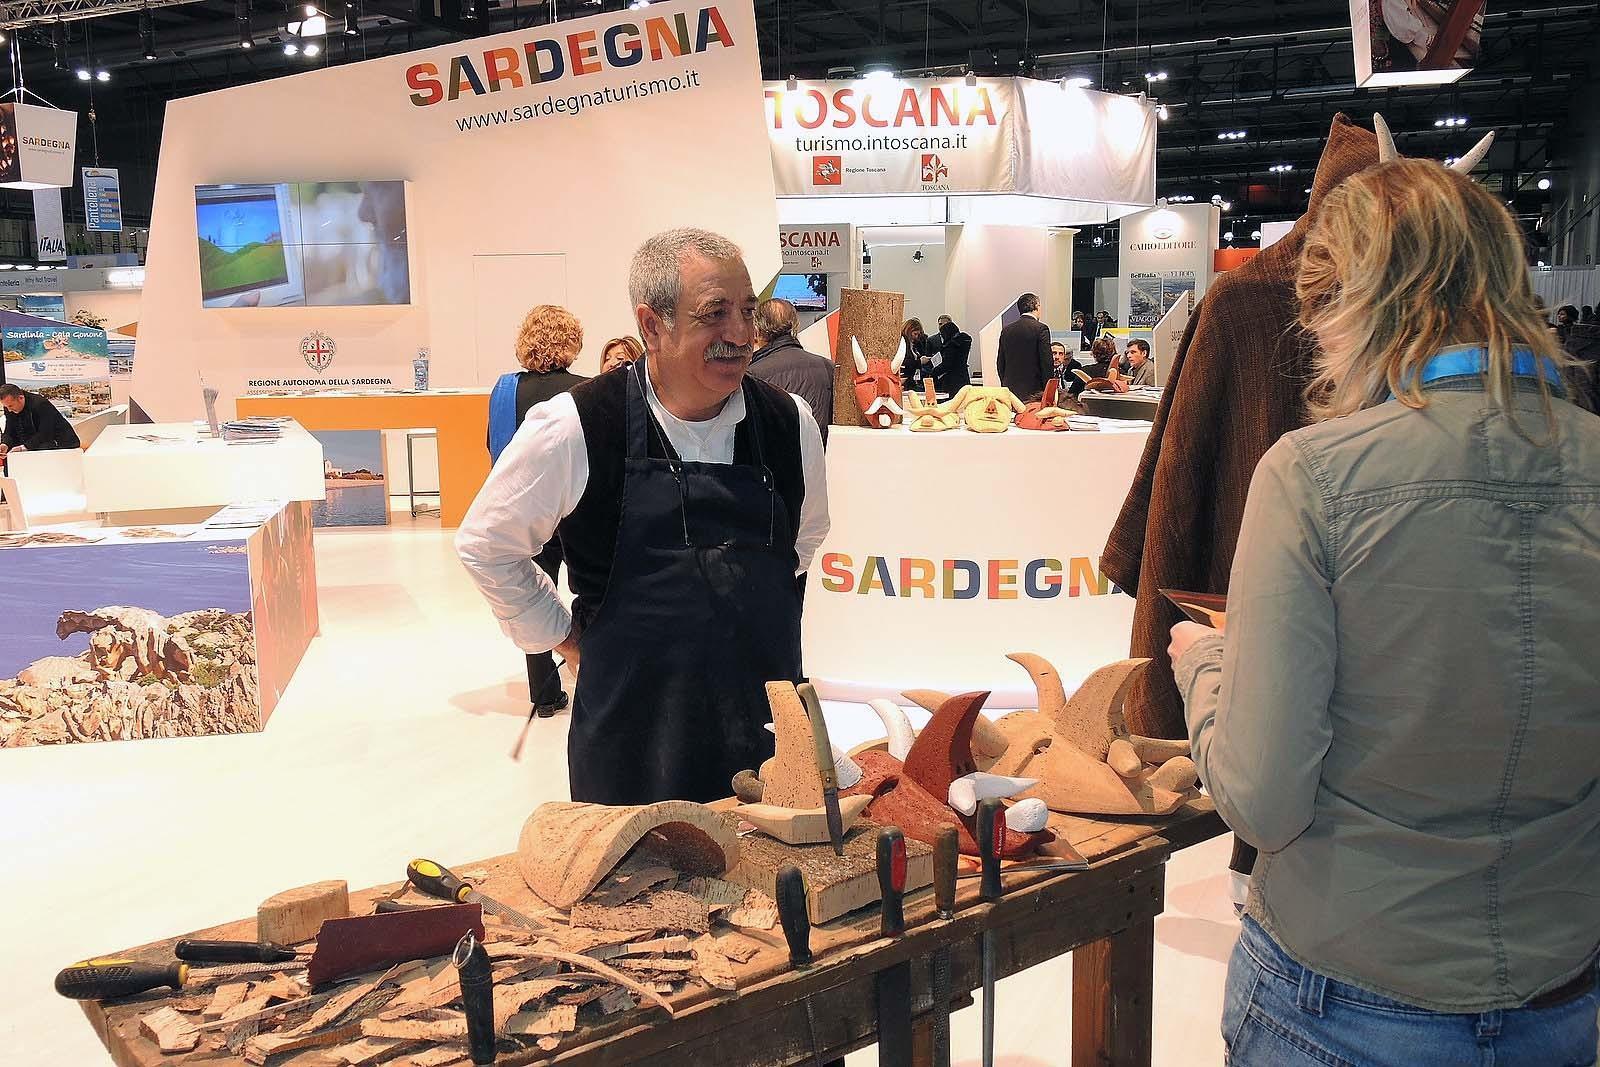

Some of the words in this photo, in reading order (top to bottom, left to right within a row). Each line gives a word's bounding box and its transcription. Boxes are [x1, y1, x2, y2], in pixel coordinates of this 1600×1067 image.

[405, 6, 735, 107] SARDEGNA
[455, 70, 701, 132] www.sardegnaturismo.it
[764, 87, 998, 129] TOSCANA
[22, 136, 71, 150] SARDEGNA
[795, 133, 968, 152] turismo.intoscana.it
[87, 177, 100, 229] Pantelleria
[40, 236, 65, 256] ITALIA
[6, 330, 45, 339] Sardinia
[248, 379, 281, 387] REGIONE
[328, 378, 350, 386] DELLA
[351, 378, 392, 386] SARDEGNA
[821, 552, 1124, 600] SARDEGN
